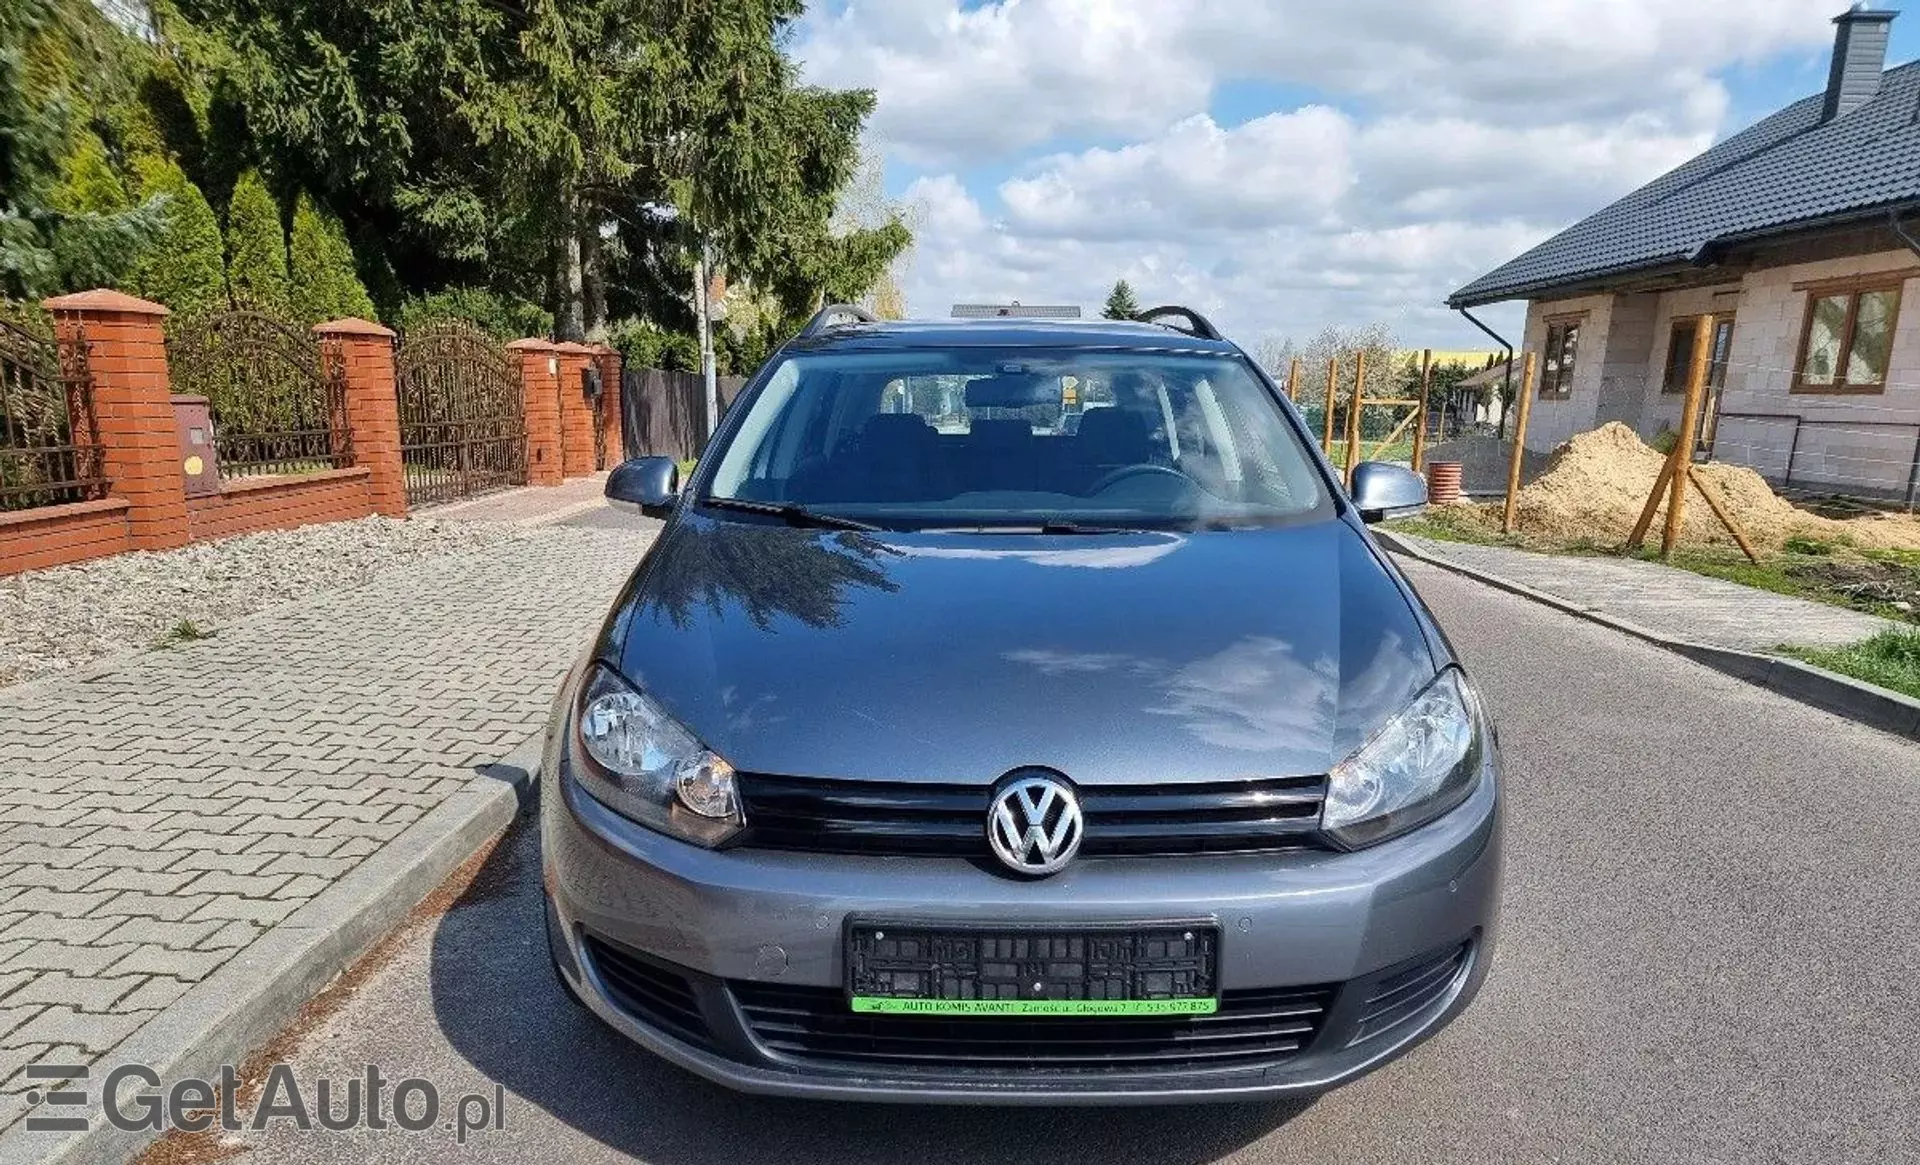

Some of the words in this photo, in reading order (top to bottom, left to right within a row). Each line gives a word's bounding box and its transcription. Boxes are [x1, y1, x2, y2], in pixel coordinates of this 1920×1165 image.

[989, 779, 1082, 873] VW
[902, 1001, 933, 1011] AUTO
[936, 1002, 971, 1012] KOMIS
